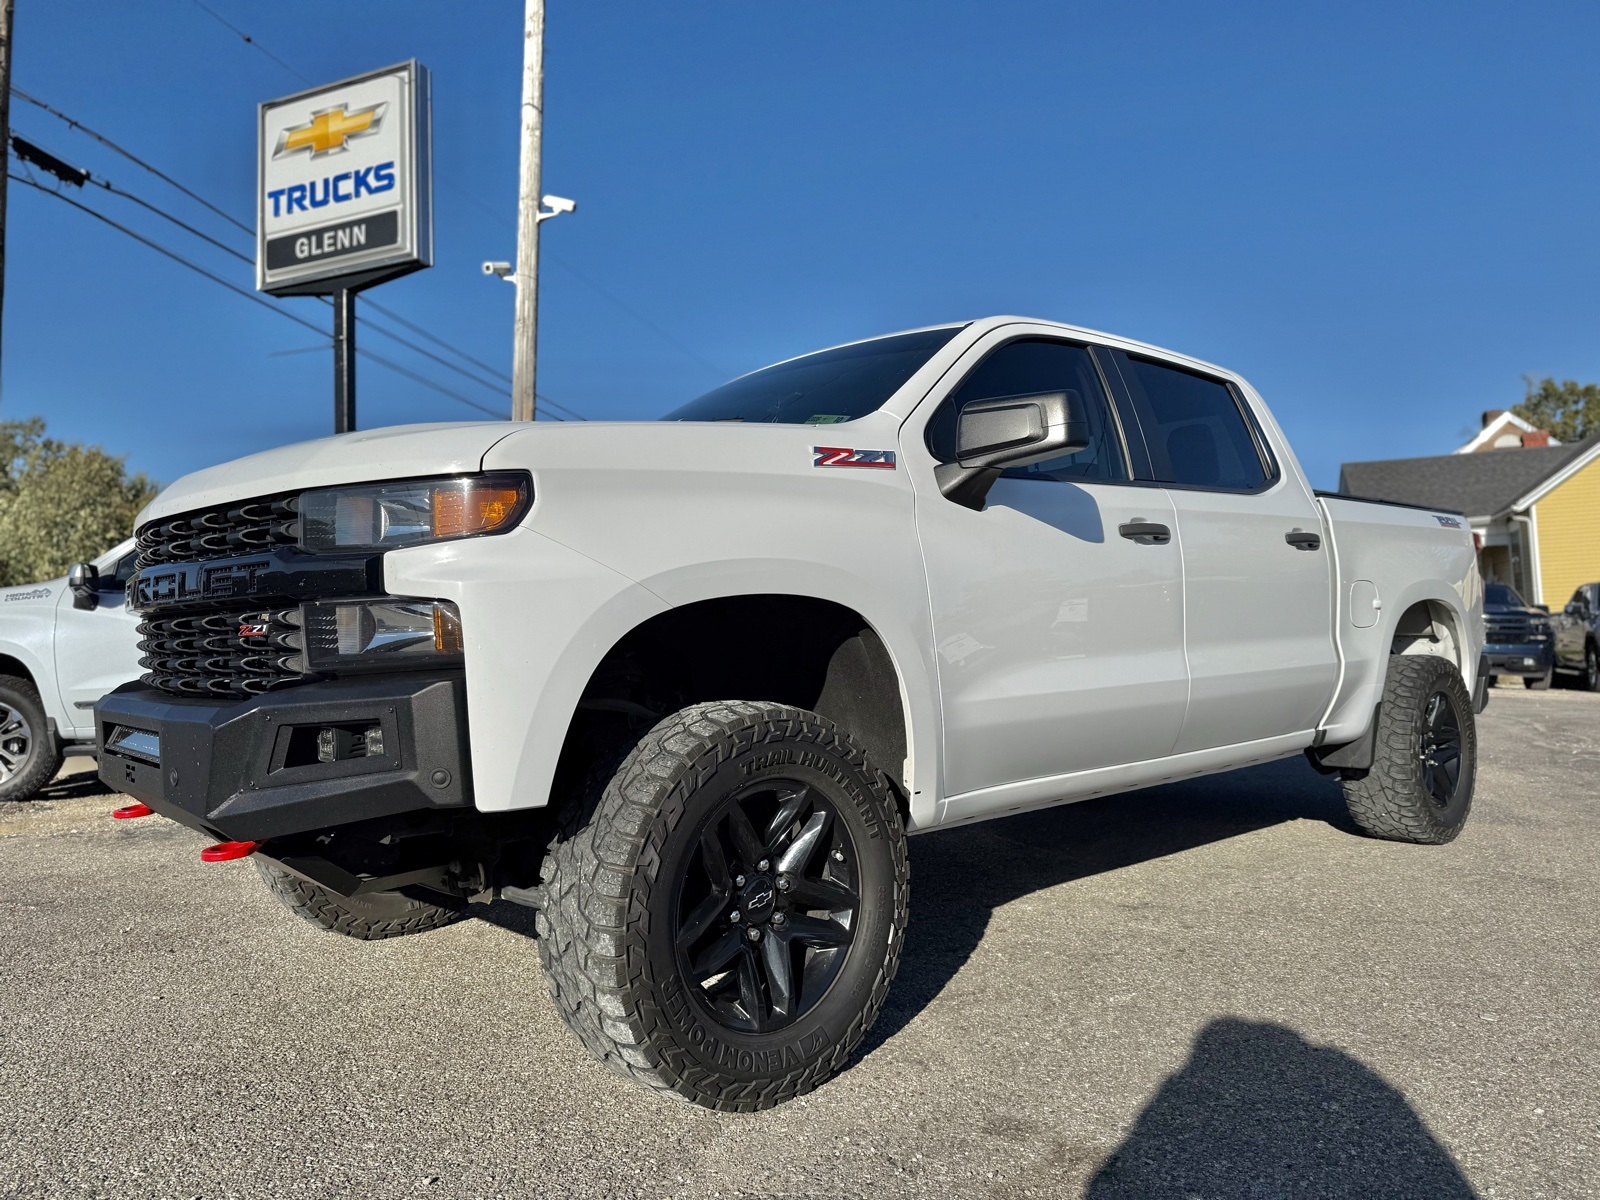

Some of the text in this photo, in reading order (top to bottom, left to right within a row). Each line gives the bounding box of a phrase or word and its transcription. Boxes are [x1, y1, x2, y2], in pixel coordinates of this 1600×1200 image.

[268, 161, 395, 218] TRUCKS
[295, 224, 367, 259] GLENN
[813, 446, 897, 470] Z71
[4, 594, 52, 602] COUNTRY
[238, 624, 268, 637] Z71
[740, 750, 796, 776] TRAIL
[799, 750, 867, 808] HUNTER
[660, 974, 800, 1074] VENOM POWER
